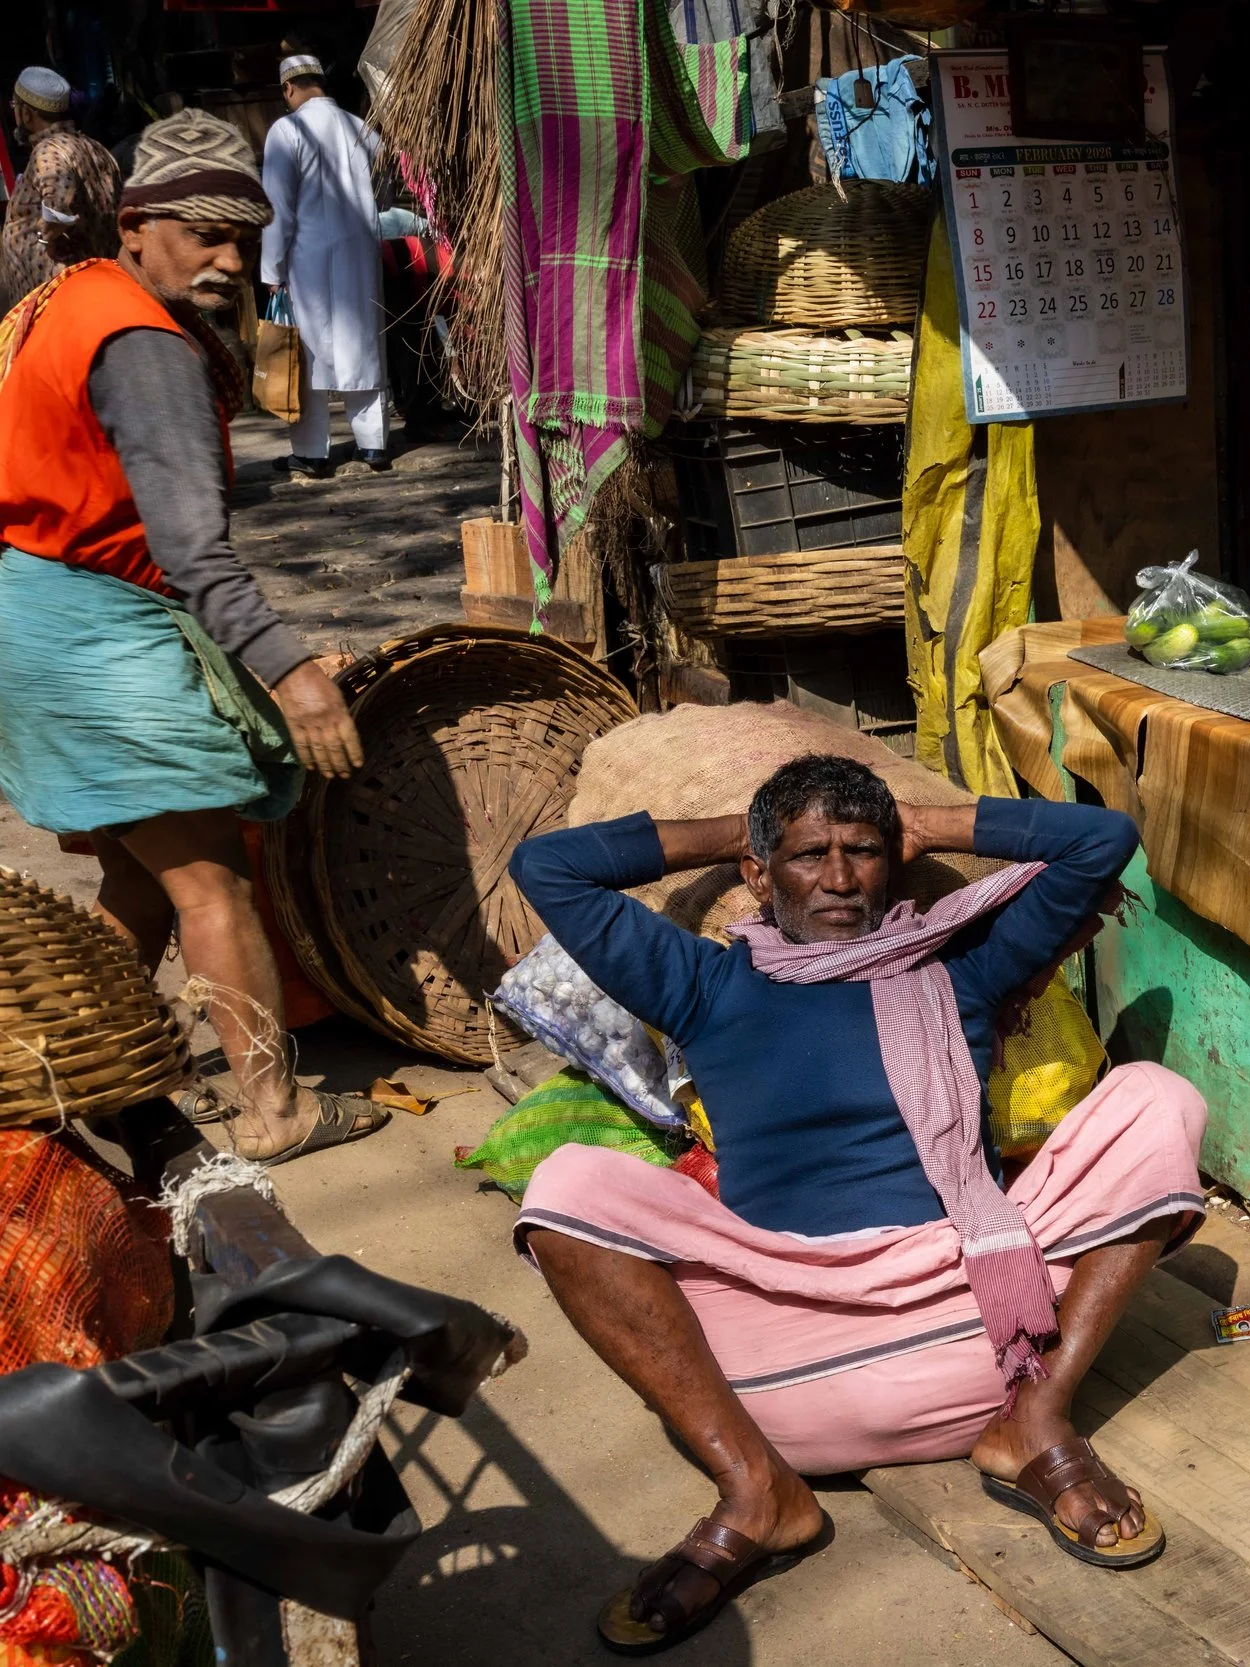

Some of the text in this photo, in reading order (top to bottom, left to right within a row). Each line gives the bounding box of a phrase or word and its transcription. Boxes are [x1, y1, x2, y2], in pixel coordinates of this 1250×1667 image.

[952, 75, 979, 98] B.
[828, 101, 845, 141] FUSS
[1016, 147, 1082, 161] FEBRUARY
[1086, 146, 1113, 159] 2026
[960, 169, 978, 177] SUN
[994, 167, 1013, 175] MON
[969, 184, 1162, 208] 1 2 3 4 5 6 7
[974, 218, 1171, 245] 8 9 10 11 12 13 14
[974, 254, 1174, 282] 15 16 17 18 19 20 21
[978, 289, 1175, 318] 22 23 24 25 26 27 28
